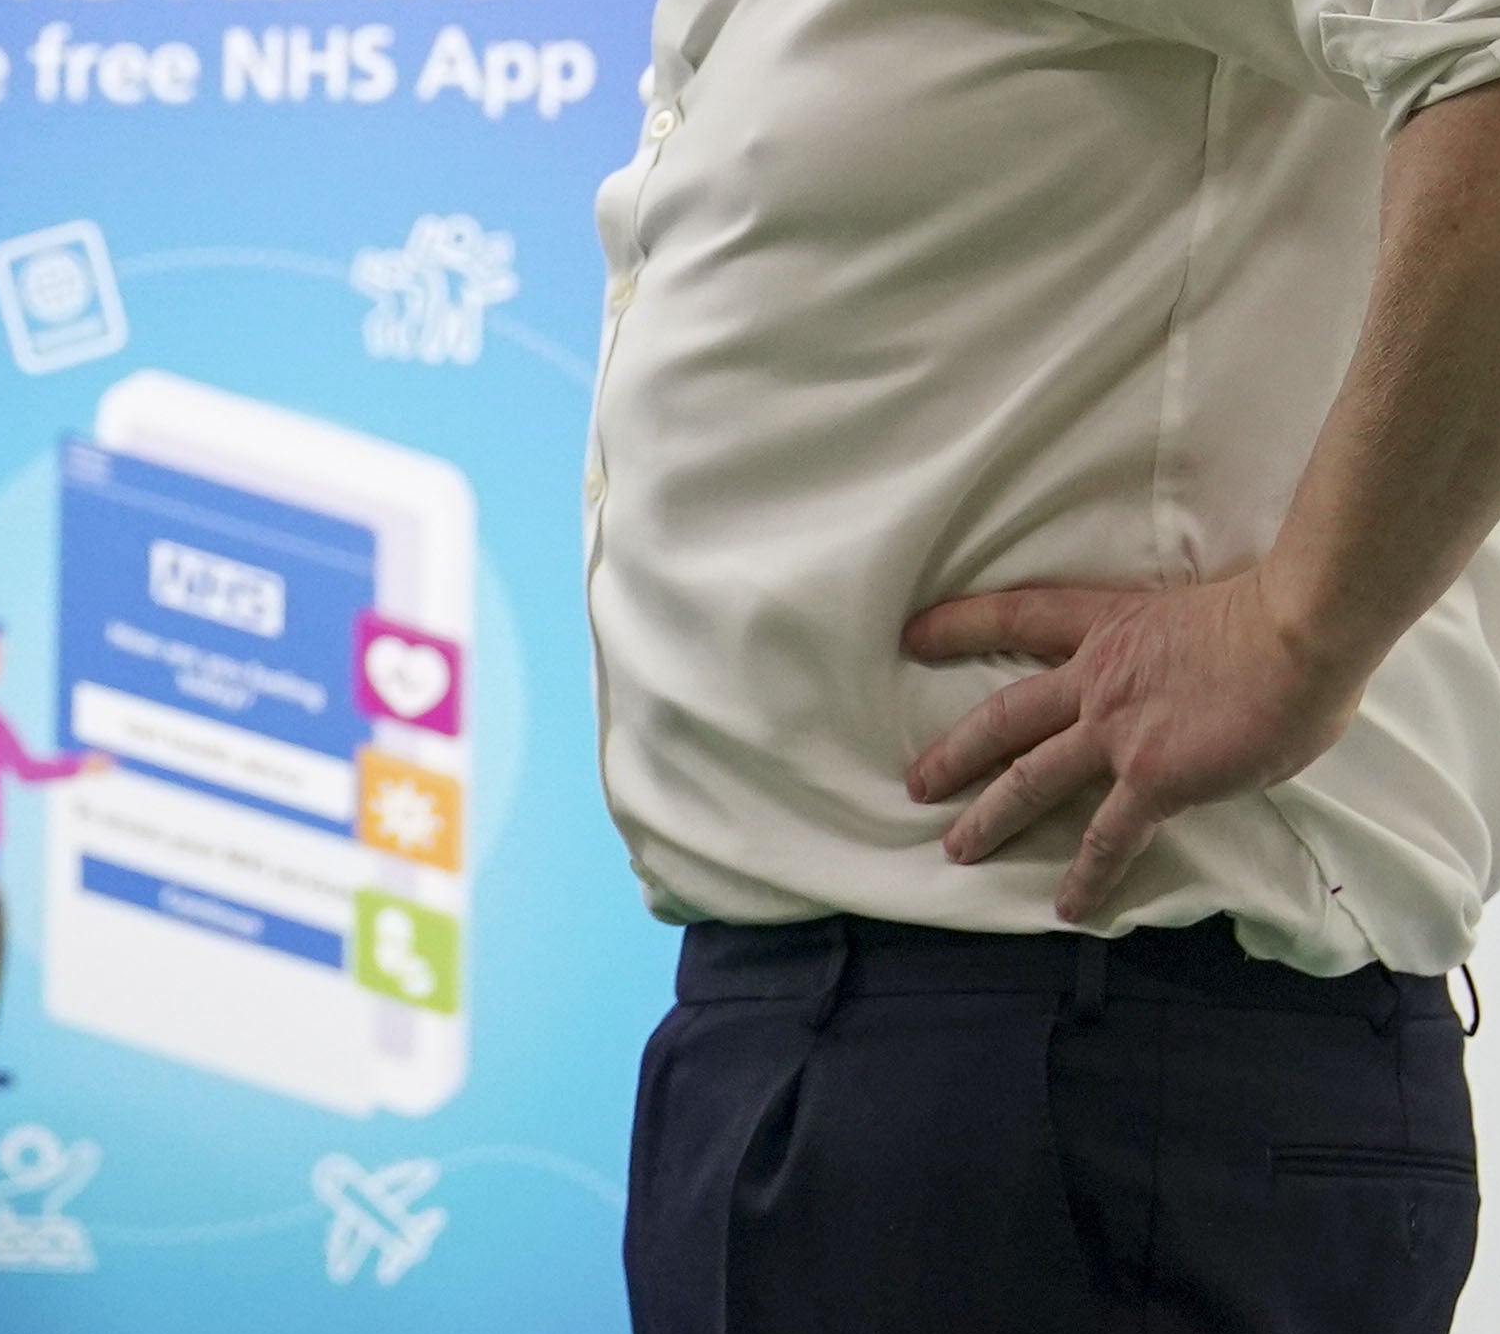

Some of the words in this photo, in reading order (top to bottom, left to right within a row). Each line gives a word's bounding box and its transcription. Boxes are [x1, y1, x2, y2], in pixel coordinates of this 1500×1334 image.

[27, 20, 200, 105] free
[222, 23, 398, 103] NHS
[415, 23, 596, 120] App
